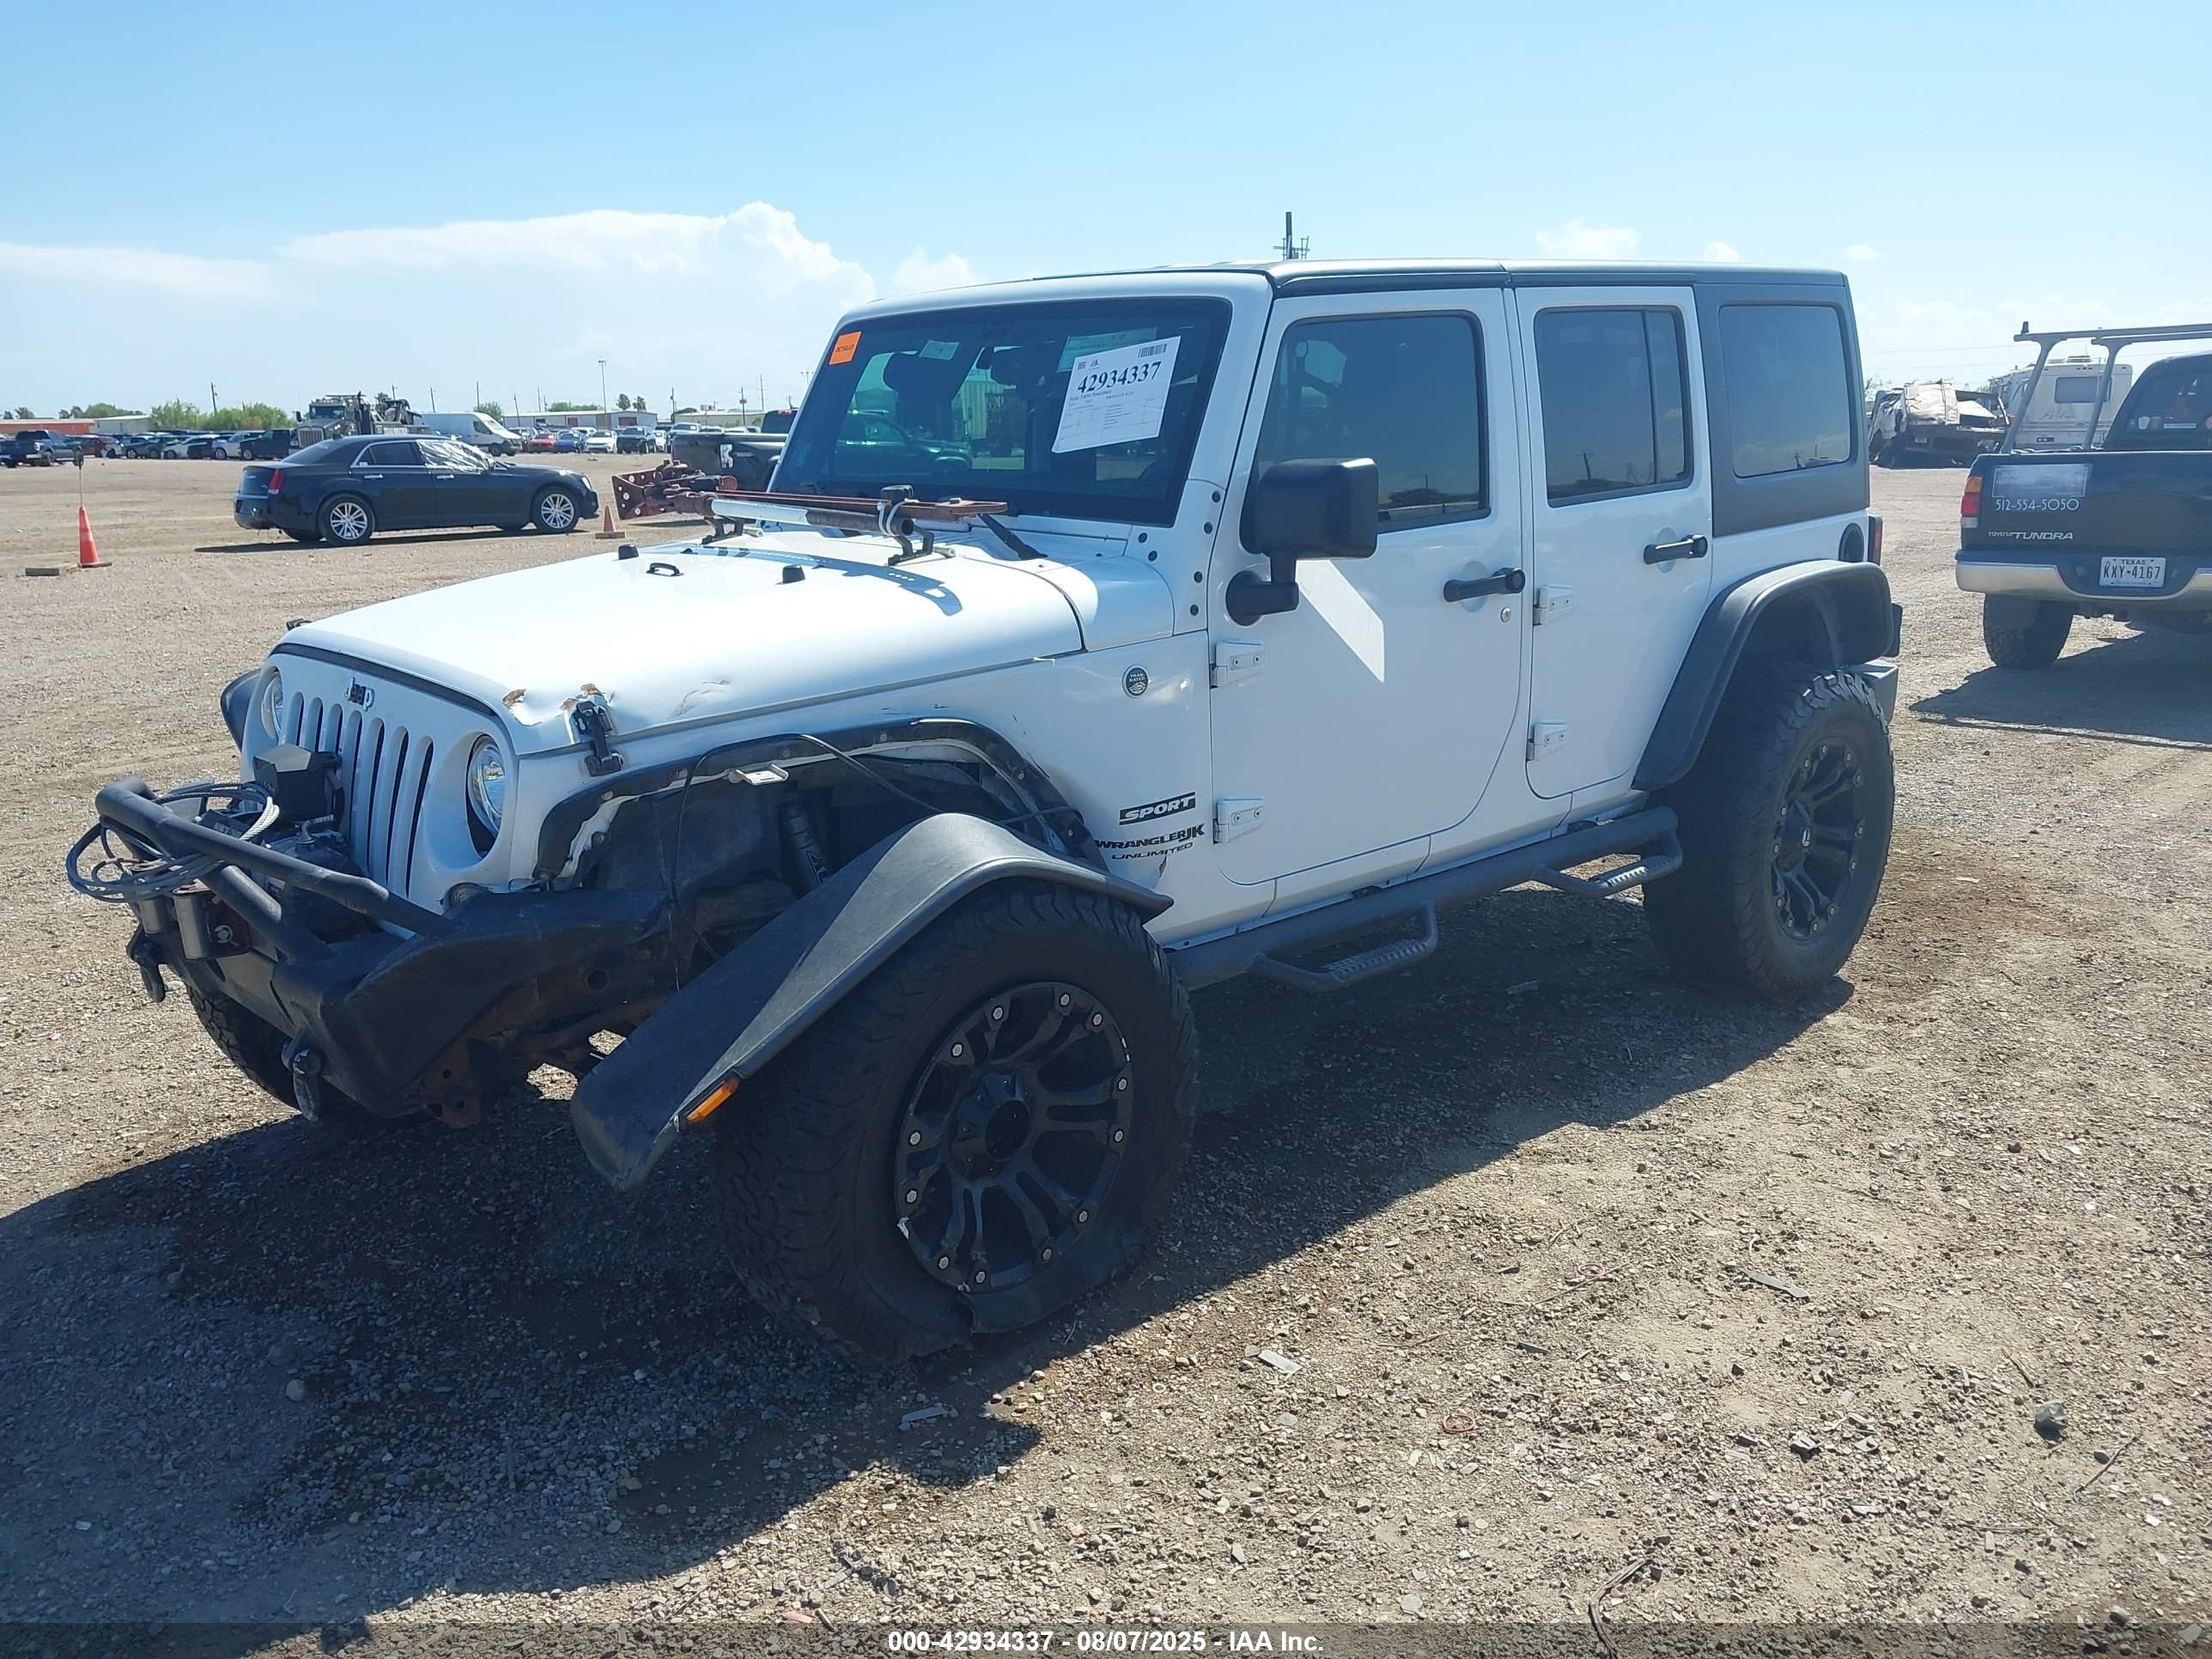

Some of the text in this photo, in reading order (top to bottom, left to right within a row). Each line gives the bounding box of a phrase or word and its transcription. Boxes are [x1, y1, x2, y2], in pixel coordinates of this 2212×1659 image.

[1077, 361, 1162, 393] 42934337
[1995, 498, 2080, 511] 512-554-5050
[2011, 532, 2074, 540] TUNDRA
[1125, 797, 1192, 819] SPORT
[1111, 842, 1194, 860] UNLIMITED
